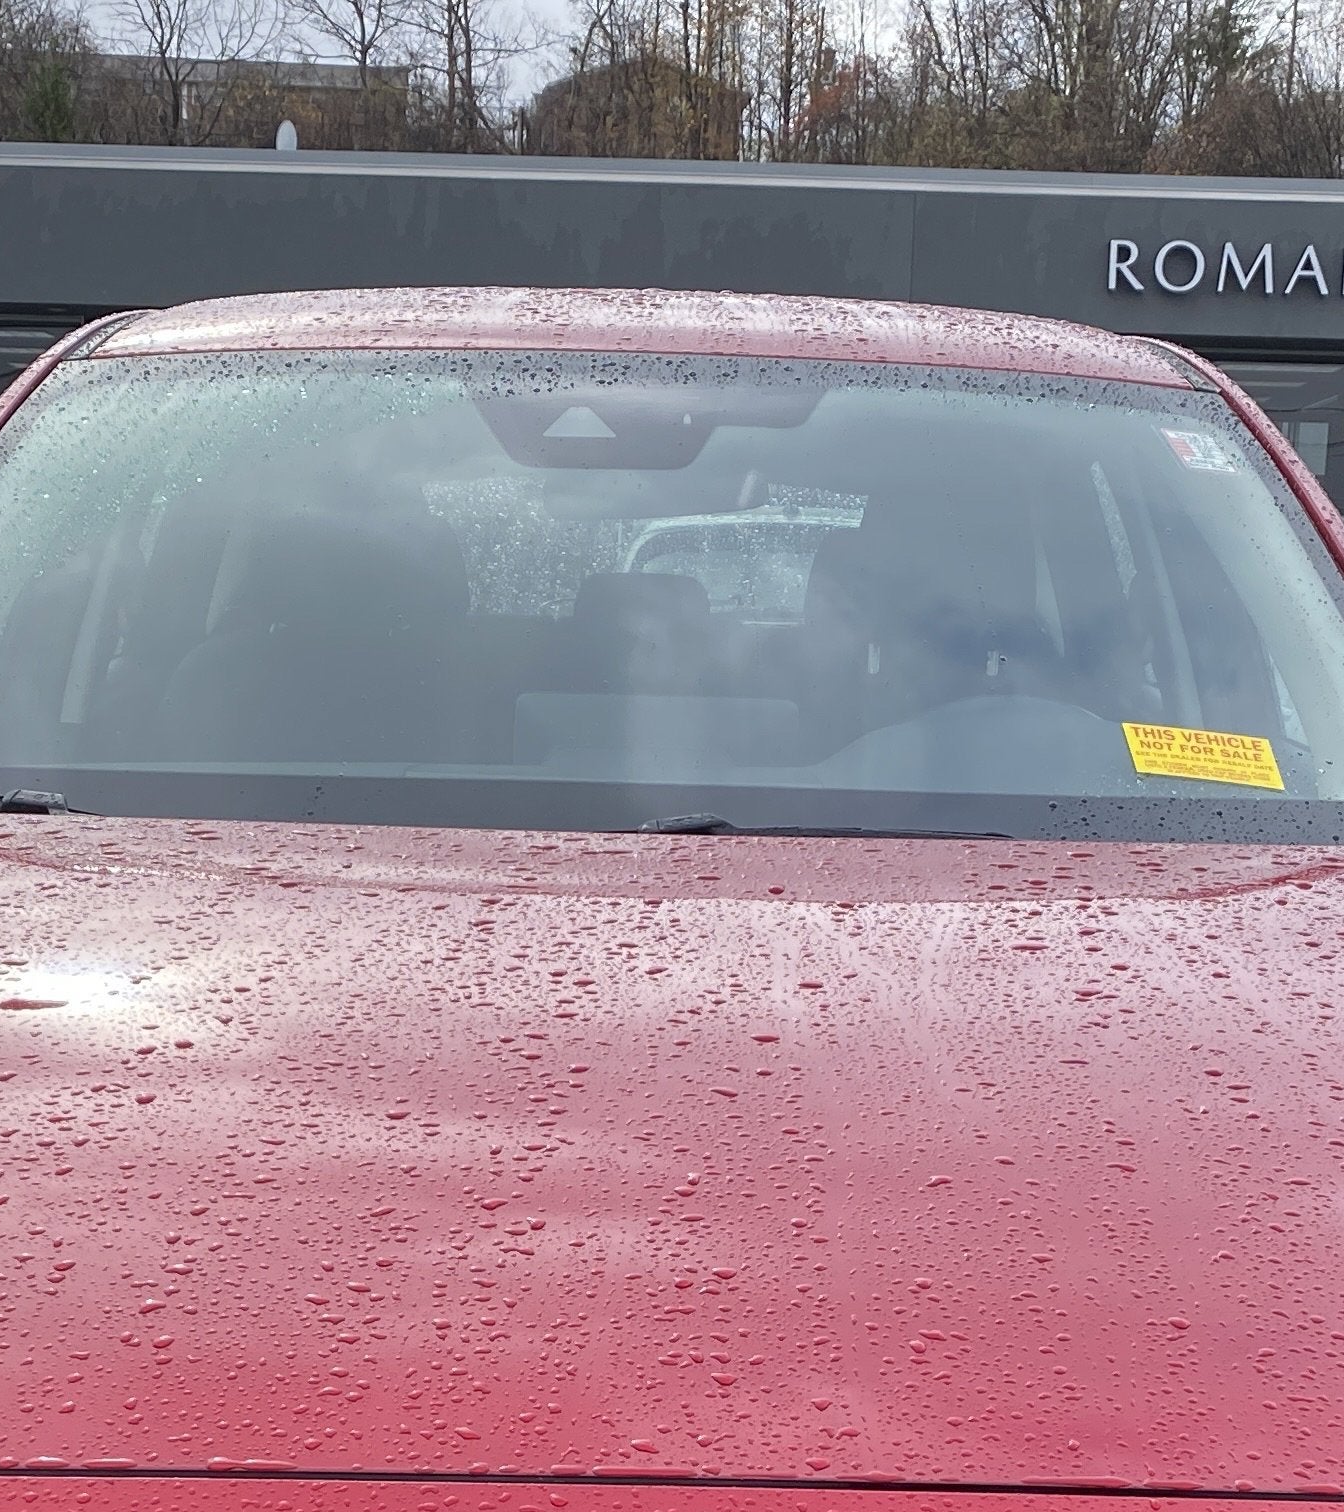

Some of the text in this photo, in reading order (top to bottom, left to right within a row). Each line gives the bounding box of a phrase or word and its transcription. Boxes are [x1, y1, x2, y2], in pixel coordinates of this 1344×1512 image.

[1131, 726, 1264, 752] THIS VEHICLE
[1140, 740, 1263, 762] NOT FOR SALE
